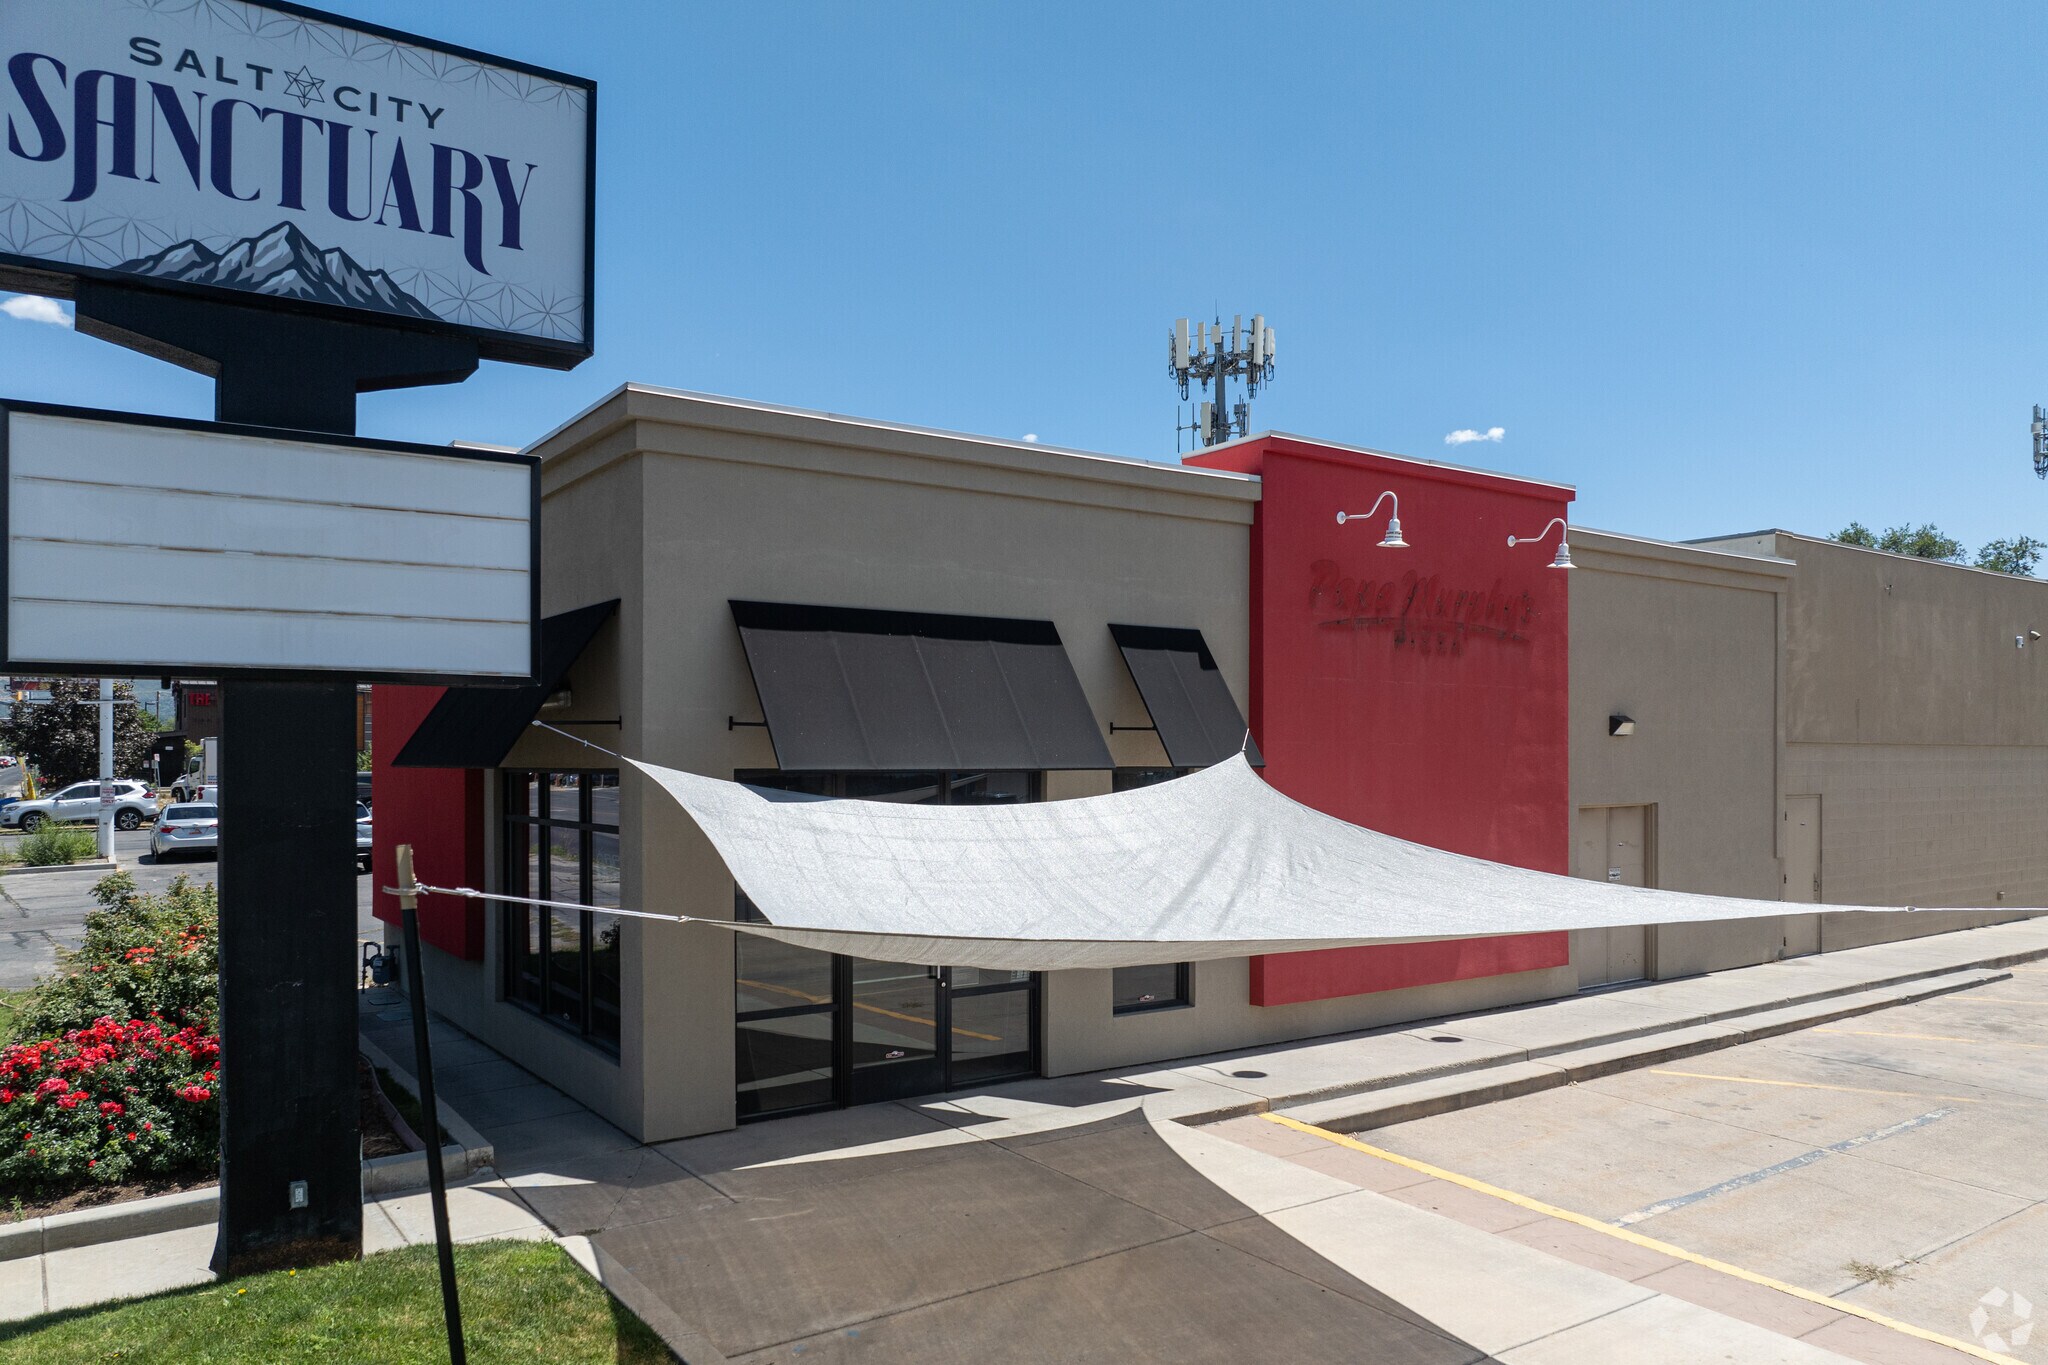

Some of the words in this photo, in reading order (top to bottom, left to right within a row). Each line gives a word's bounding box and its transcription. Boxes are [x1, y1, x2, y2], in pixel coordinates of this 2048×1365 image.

[129, 36, 274, 92] SALT
[333, 85, 445, 130] CITY
[7, 52, 538, 277] SANCTUARY
